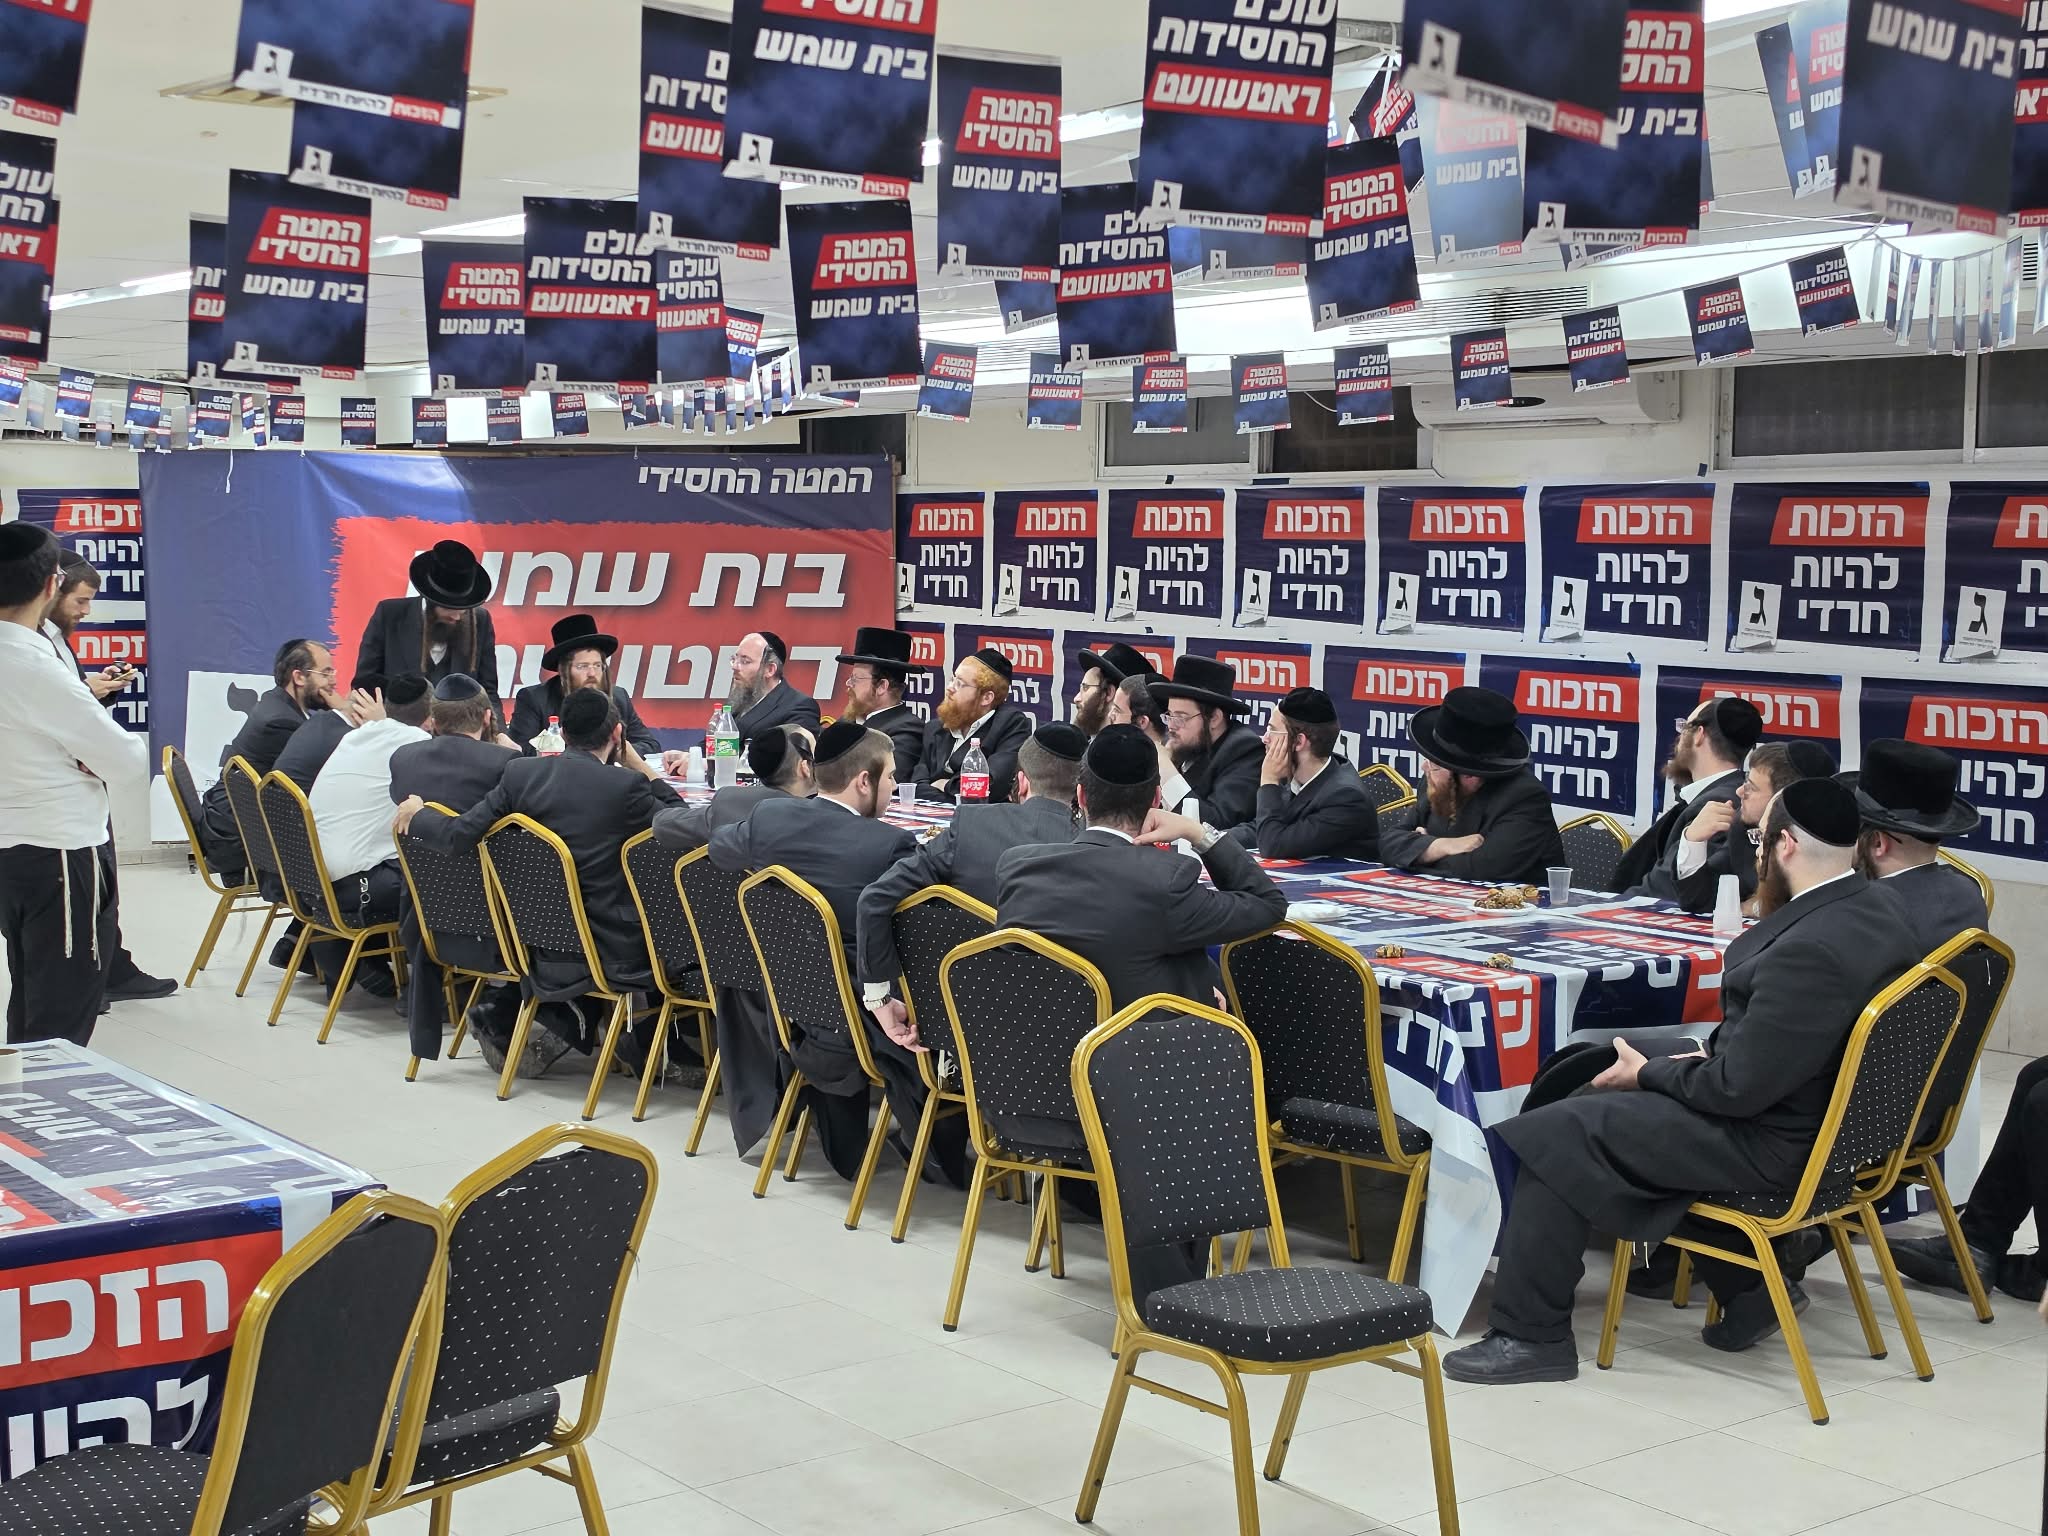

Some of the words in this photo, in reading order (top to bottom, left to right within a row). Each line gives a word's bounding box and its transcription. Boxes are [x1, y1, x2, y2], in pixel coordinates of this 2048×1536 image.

[1152, 16, 1327, 67] החסידות
[1866, 1, 1957, 62] שמש
[754, 28, 857, 71] שמש
[863, 44, 928, 81] בית
[1959, 29, 2016, 79] בית
[1620, 53, 1692, 85] החס
[644, 74, 727, 114] סידות
[1153, 71, 1322, 117] ראטעוועט
[979, 95, 1053, 126] המטה
[1640, 108, 1698, 136] בית
[964, 122, 1053, 153] החסידי
[0, 161, 54, 195] עול
[952, 165, 1014, 191] שמש
[1436, 159, 1482, 186] שמש
[1487, 157, 1518, 179] בית
[819, 173, 858, 190] להיות
[864, 181, 906, 197] הזכות
[1018, 170, 1057, 194] בית
[1330, 171, 1395, 202] המטה
[277, 214, 362, 243] המטה
[1226, 214, 1263, 230] להיות
[834, 236, 906, 261] המטה
[1314, 232, 1368, 261] שמש
[1374, 224, 1409, 249] בית
[1608, 229, 1641, 243] להיות
[1646, 230, 1684, 243] הזכות
[258, 237, 361, 267] החסידי
[1059, 235, 1164, 266] החסידות
[459, 267, 519, 286] המטה
[528, 256, 652, 283] החסידות
[668, 257, 719, 279] עולם
[820, 260, 907, 284] החסידי
[1816, 258, 1847, 275] עולם
[242, 273, 316, 298] שמש
[319, 281, 365, 304] בית
[657, 279, 719, 300] החסיד
[1061, 268, 1165, 297] ראטעוועט
[1795, 269, 1848, 291] החסידות
[448, 287, 520, 305] החסידי
[530, 291, 651, 316] ראטעוועט
[810, 297, 872, 319] שמש
[878, 294, 915, 316] בית
[1700, 301, 1742, 317] החסידי
[1705, 291, 1739, 306] המטה
[439, 318, 490, 335] שמש
[494, 319, 525, 335] בית
[657, 306, 720, 328] ראטעוו
[1589, 315, 1620, 331] עולם
[1698, 320, 1727, 334] שמש
[1729, 314, 1748, 328] בית
[1470, 340, 1504, 353] המטה
[1567, 327, 1620, 346] החסידות
[1359, 353, 1389, 366] עולם
[1463, 350, 1505, 363] החסידי
[1336, 365, 1388, 379] החסידות
[1490, 364, 1508, 376] בית
[638, 466, 761, 494] החסידי
[770, 466, 873, 494] המטה
[69, 503, 142, 527] זכות
[918, 508, 974, 532] הזכות
[1024, 506, 1087, 532] הזכות
[1143, 506, 1211, 532] הזכות
[1275, 505, 1351, 533] הזכות
[1422, 505, 1508, 534] הזכות
[1592, 504, 1693, 536] הזכות
[1788, 504, 1904, 538] הזכות
[75, 536, 143, 562] היות
[919, 541, 972, 567] להיות
[1026, 541, 1085, 569] להיות
[1144, 543, 1209, 572] להיות
[1277, 544, 1349, 575] להיות
[1426, 547, 1508, 580] להיות
[1596, 549, 1690, 585] להיות
[1791, 552, 1899, 591] להיות
[688, 553, 846, 608] בית
[923, 574, 968, 598] חרדי
[1030, 576, 1080, 601] חרדי
[1149, 580, 1204, 606] חרדי
[1281, 583, 1343, 612] חרדי
[1431, 588, 1501, 618] חרדי
[1602, 592, 1682, 626] חרדי
[1798, 599, 1889, 634] חרדי
[1968, 591, 1988, 635] ג
[77, 635, 145, 659] זכות
[1366, 667, 1449, 700] הזכות
[1527, 677, 1622, 713] הזכות
[1367, 710, 1410, 741] יות
[1924, 704, 2048, 745] הזכות
[1530, 724, 1619, 760] להיות
[1956, 759, 2046, 799] להיו
[0, 1258, 230, 1368] הזכו
[7, 1373, 210, 1480] להיו
